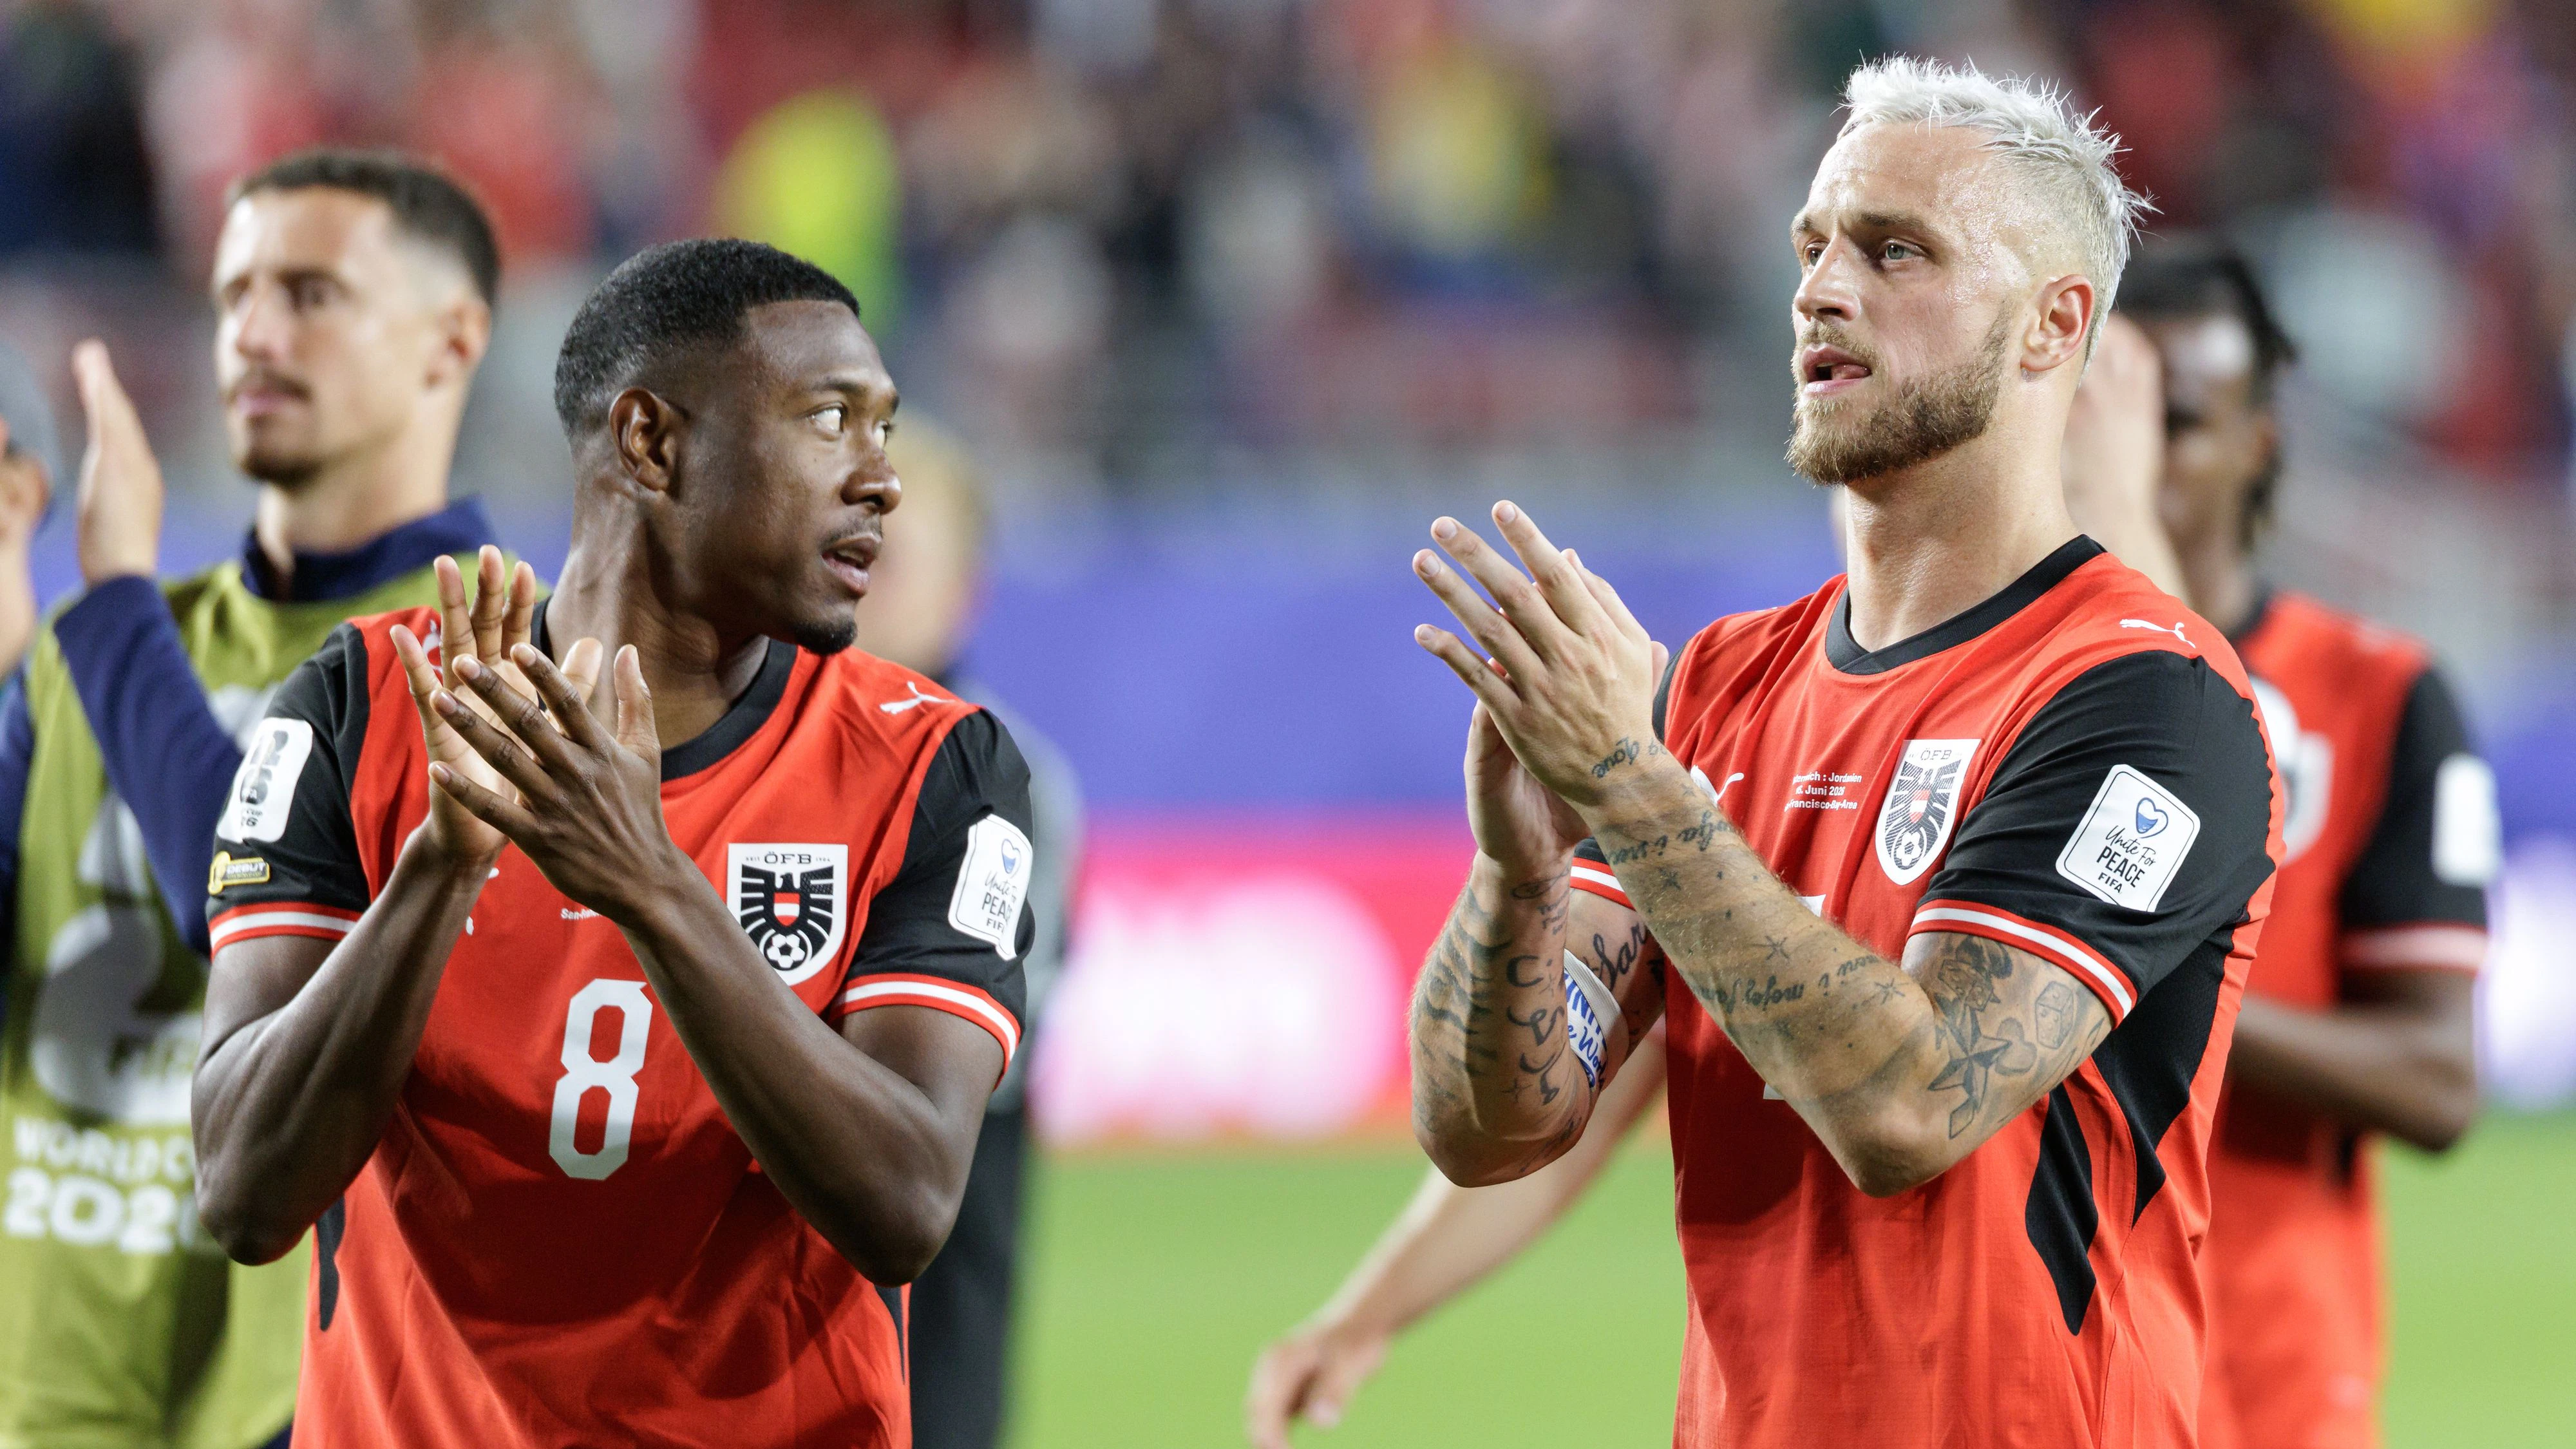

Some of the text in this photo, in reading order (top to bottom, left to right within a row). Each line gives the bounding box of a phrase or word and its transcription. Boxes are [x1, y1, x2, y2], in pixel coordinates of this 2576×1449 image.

[1920, 748, 1952, 761] ÖFB
[1805, 784, 1827, 795] Juni
[764, 851, 811, 864] ÖFB
[2105, 825, 2156, 866] Unite For
[2096, 846, 2145, 888] PEACE
[985, 870, 1011, 895] Unite
[2098, 872, 2123, 893] FIFA
[549, 978, 652, 1180] 8
[14, 1115, 159, 1184] WORLD
